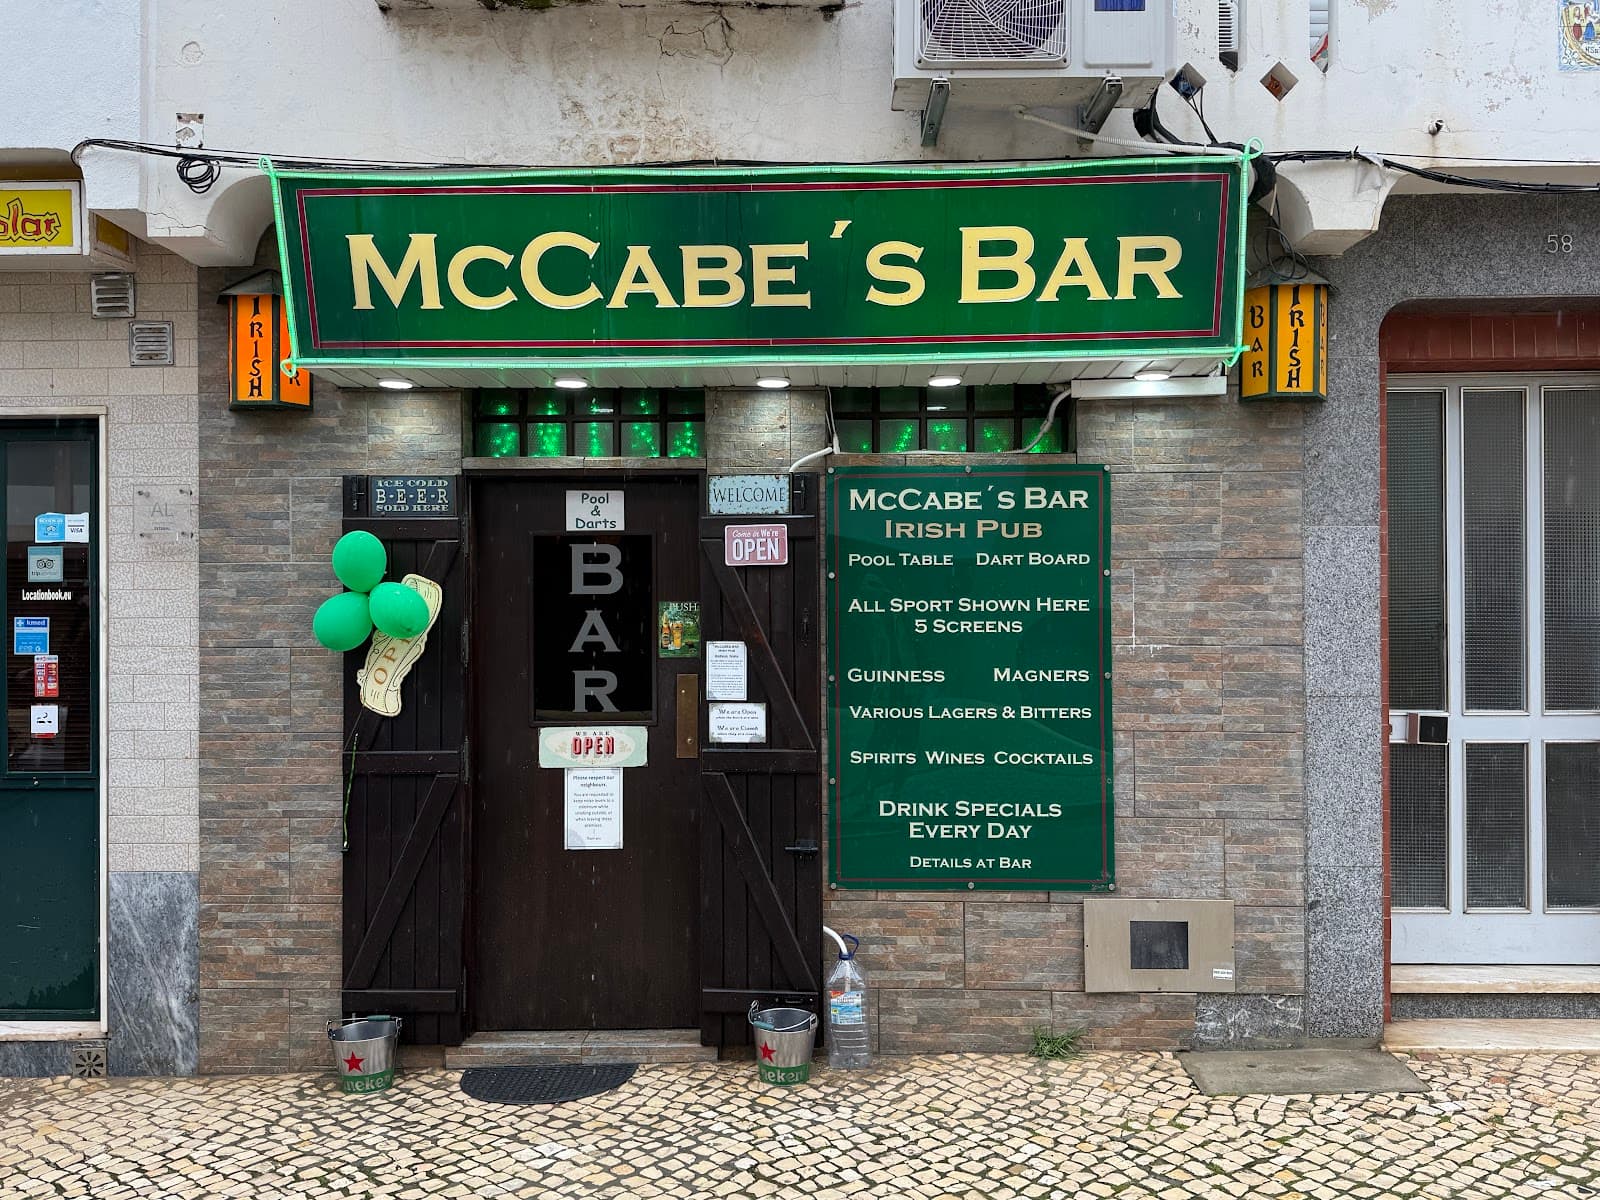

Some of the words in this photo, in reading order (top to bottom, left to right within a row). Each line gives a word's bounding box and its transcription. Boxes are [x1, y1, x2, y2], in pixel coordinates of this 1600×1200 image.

[1547, 234, 1573, 253] 58
[958, 226, 1184, 303] BAR
[1250, 305, 1265, 378] BAR
[1286, 285, 1305, 388] IRISH
[249, 296, 264, 397] IRISH
[377, 479, 404, 487] ICE
[406, 479, 449, 487] COLD
[581, 493, 610, 505] Pool
[713, 487, 786, 503] WELCOME
[1024, 487, 1089, 510] BAR
[375, 504, 410, 512] SOLD
[412, 504, 449, 512] HERE
[590, 505, 601, 517] &
[575, 518, 617, 529] Darts
[884, 519, 966, 539] IRISH
[976, 519, 1043, 538] PUB
[732, 529, 751, 538] Come
[761, 528, 779, 537] We're
[732, 538, 780, 561] OPEN
[848, 553, 896, 567] POOL
[898, 553, 954, 566] TABLE
[976, 553, 1024, 566] DART
[1028, 552, 1091, 565] BOARD
[22, 589, 72, 600] Locationbook.eu
[669, 602, 698, 612] PUSH
[848, 598, 885, 613] ALL
[890, 598, 954, 612] SPORT
[958, 598, 1031, 612] SHOWN
[1035, 597, 1090, 612] HERE
[568, 544, 624, 713] BAR
[914, 619, 928, 634] 5
[933, 619, 1023, 634] SCREENS
[847, 668, 945, 683] GUINNESS
[993, 667, 1090, 682] MAGNERS
[849, 705, 924, 719] VARIOUS
[928, 705, 998, 719] LAGERS
[1001, 706, 1016, 719] &
[1020, 706, 1092, 719] BITTERS
[571, 736, 615, 757] OPEN
[850, 751, 917, 765] SPIRITS
[925, 751, 985, 765] WINES
[994, 751, 1094, 765] COCKTAILS
[879, 800, 949, 817] DRINK
[955, 800, 1062, 817] SPECIALS
[909, 822, 981, 839] EVERY
[987, 823, 1032, 839] DAY
[910, 856, 972, 868] DETAILS
[999, 857, 1032, 869] BAR
